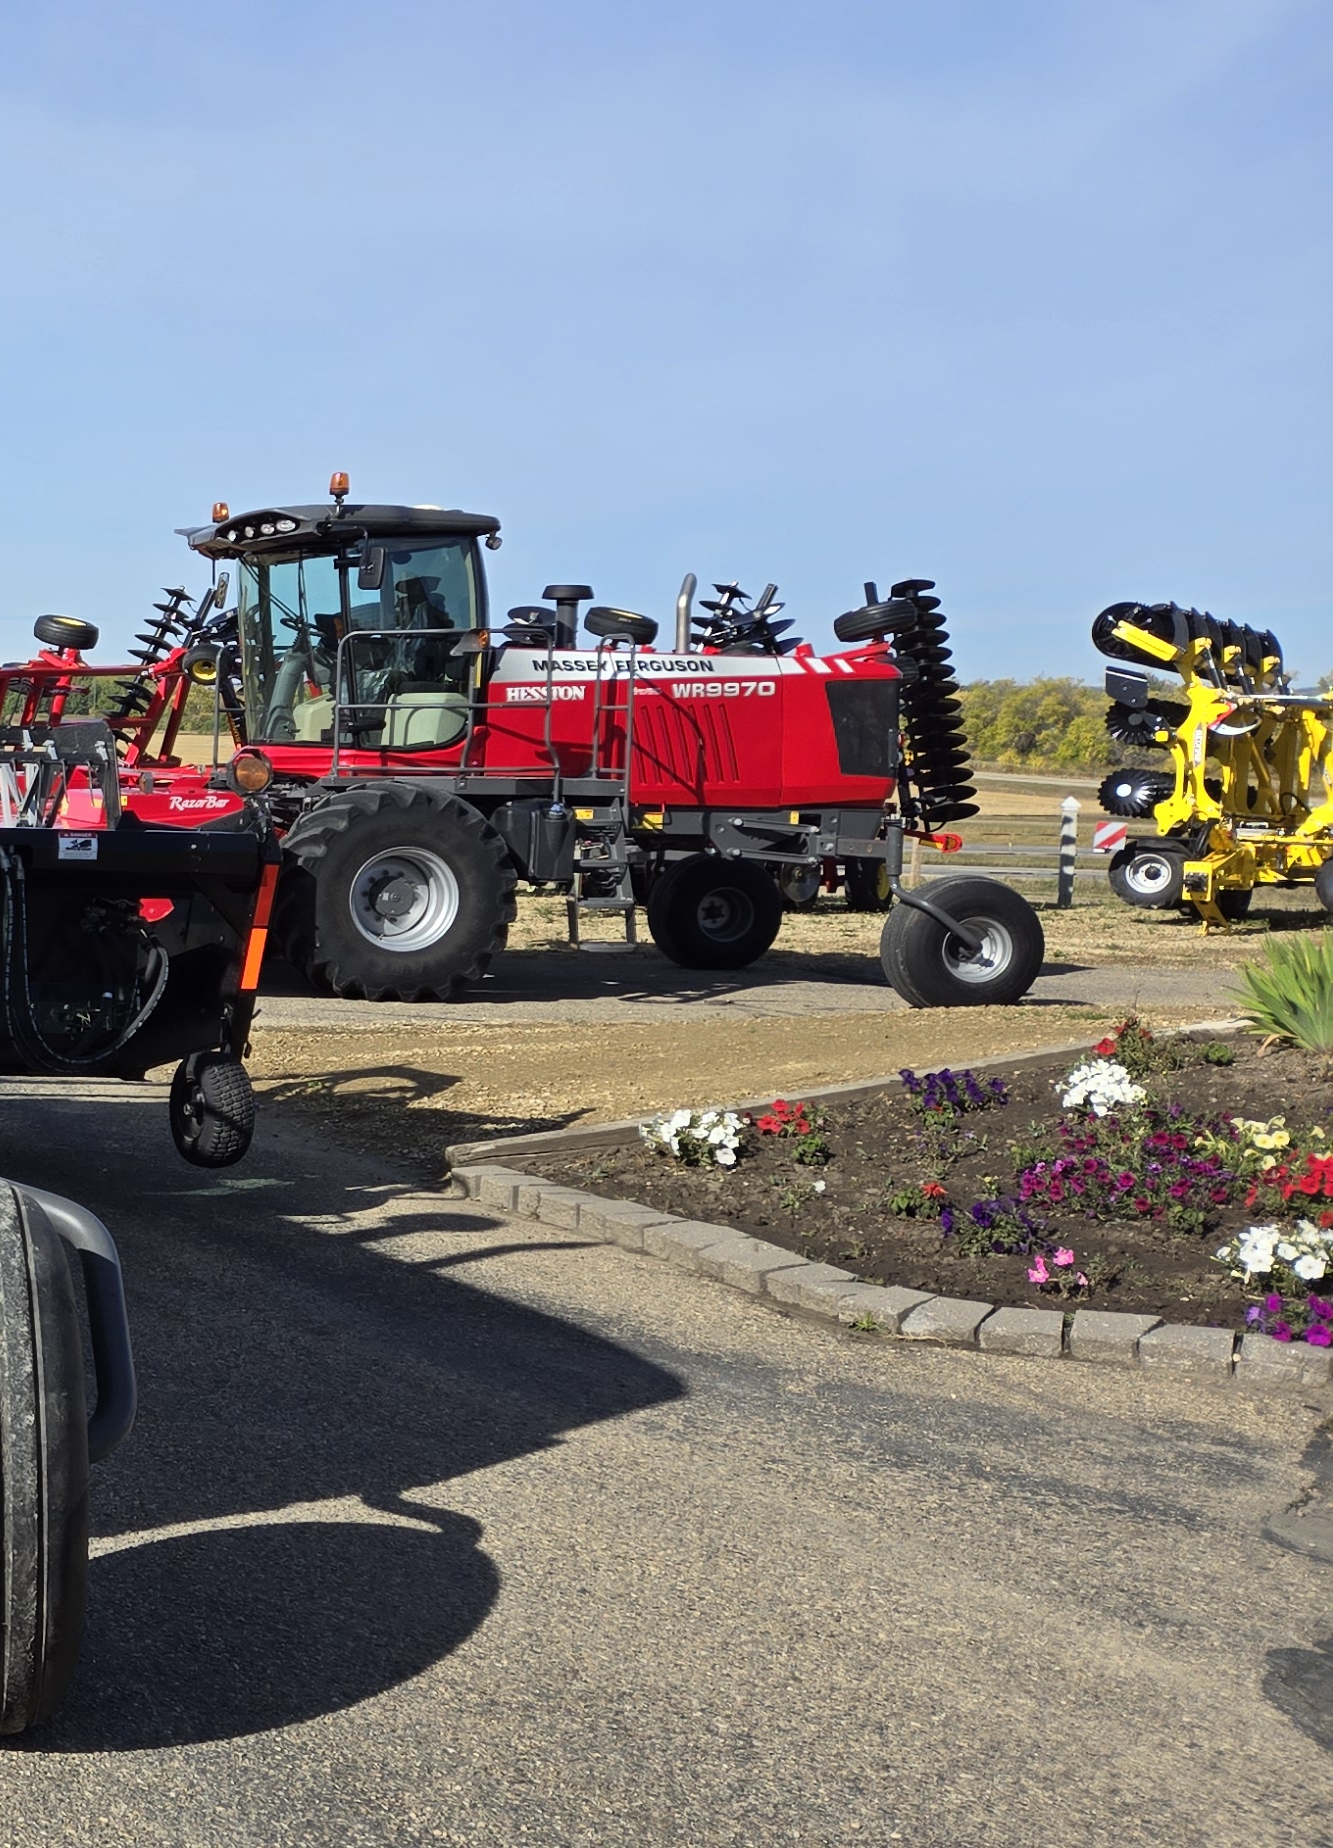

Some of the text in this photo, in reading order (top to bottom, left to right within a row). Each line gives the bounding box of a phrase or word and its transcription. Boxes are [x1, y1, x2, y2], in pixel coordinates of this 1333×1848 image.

[532, 659, 715, 672] MASSEY FERGUSON
[505, 686, 587, 702] HESSTON
[671, 681, 776, 698] WR9970
[169, 795, 230, 811] RazorBar
